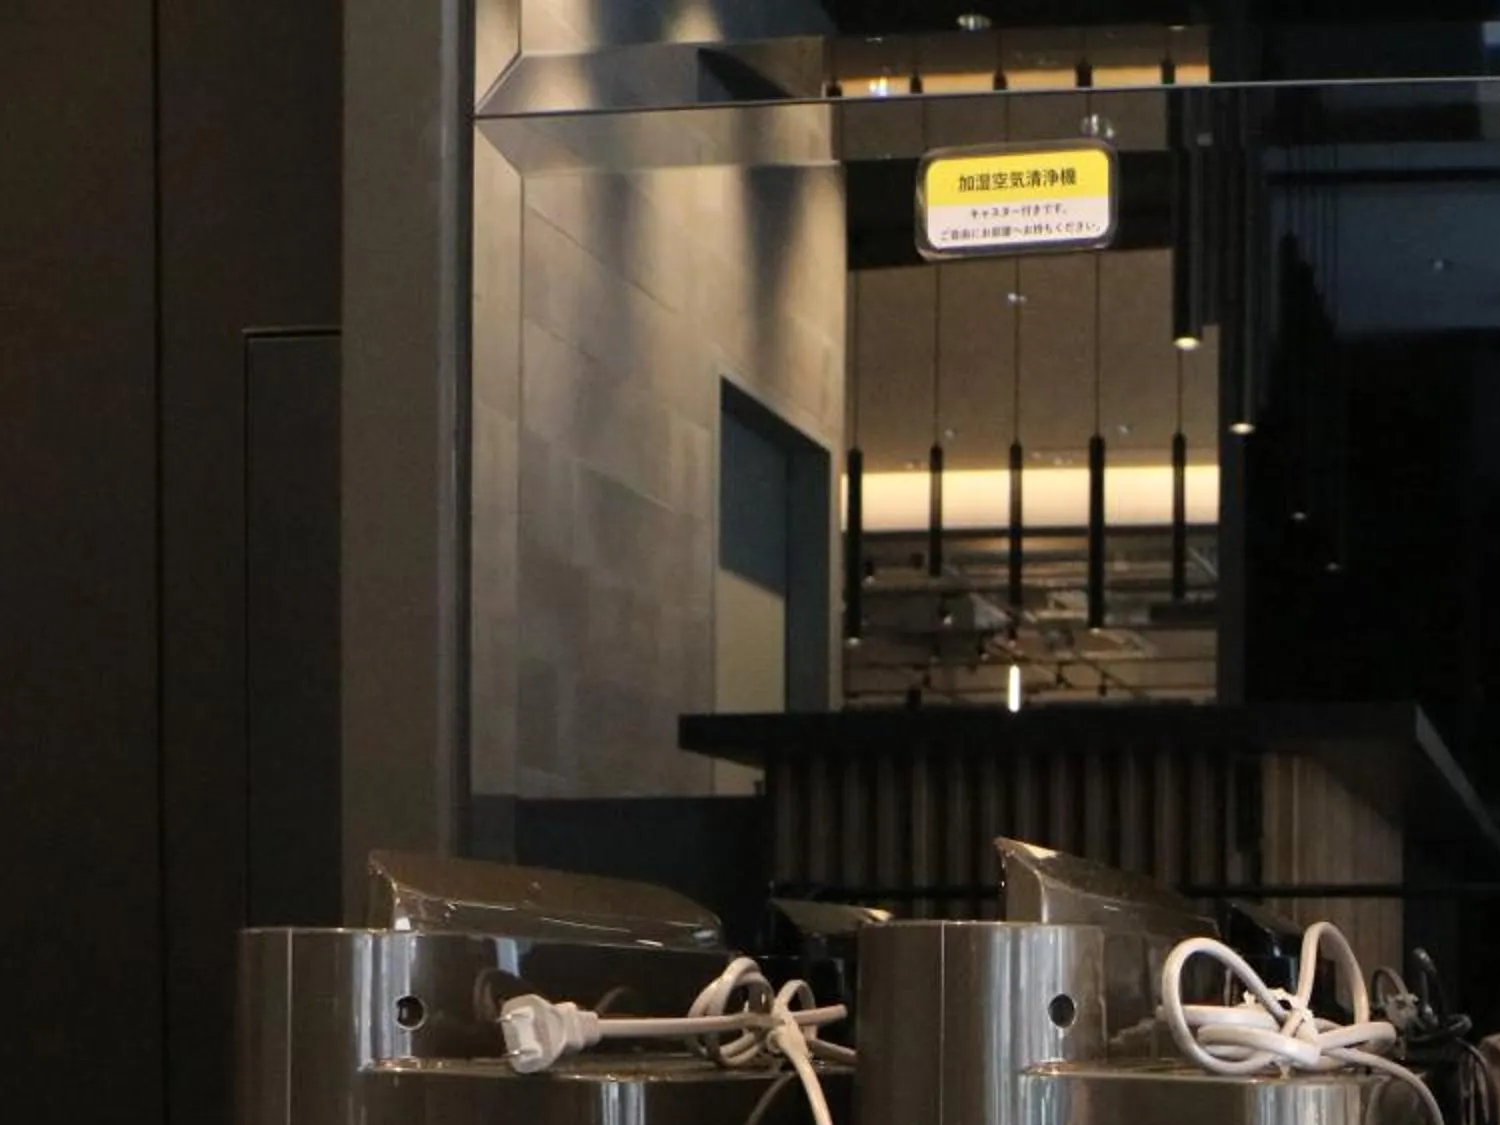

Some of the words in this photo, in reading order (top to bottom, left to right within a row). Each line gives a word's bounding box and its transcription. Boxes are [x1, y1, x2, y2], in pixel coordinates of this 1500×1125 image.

[958, 167, 1077, 192] 加湿空気清浄機
